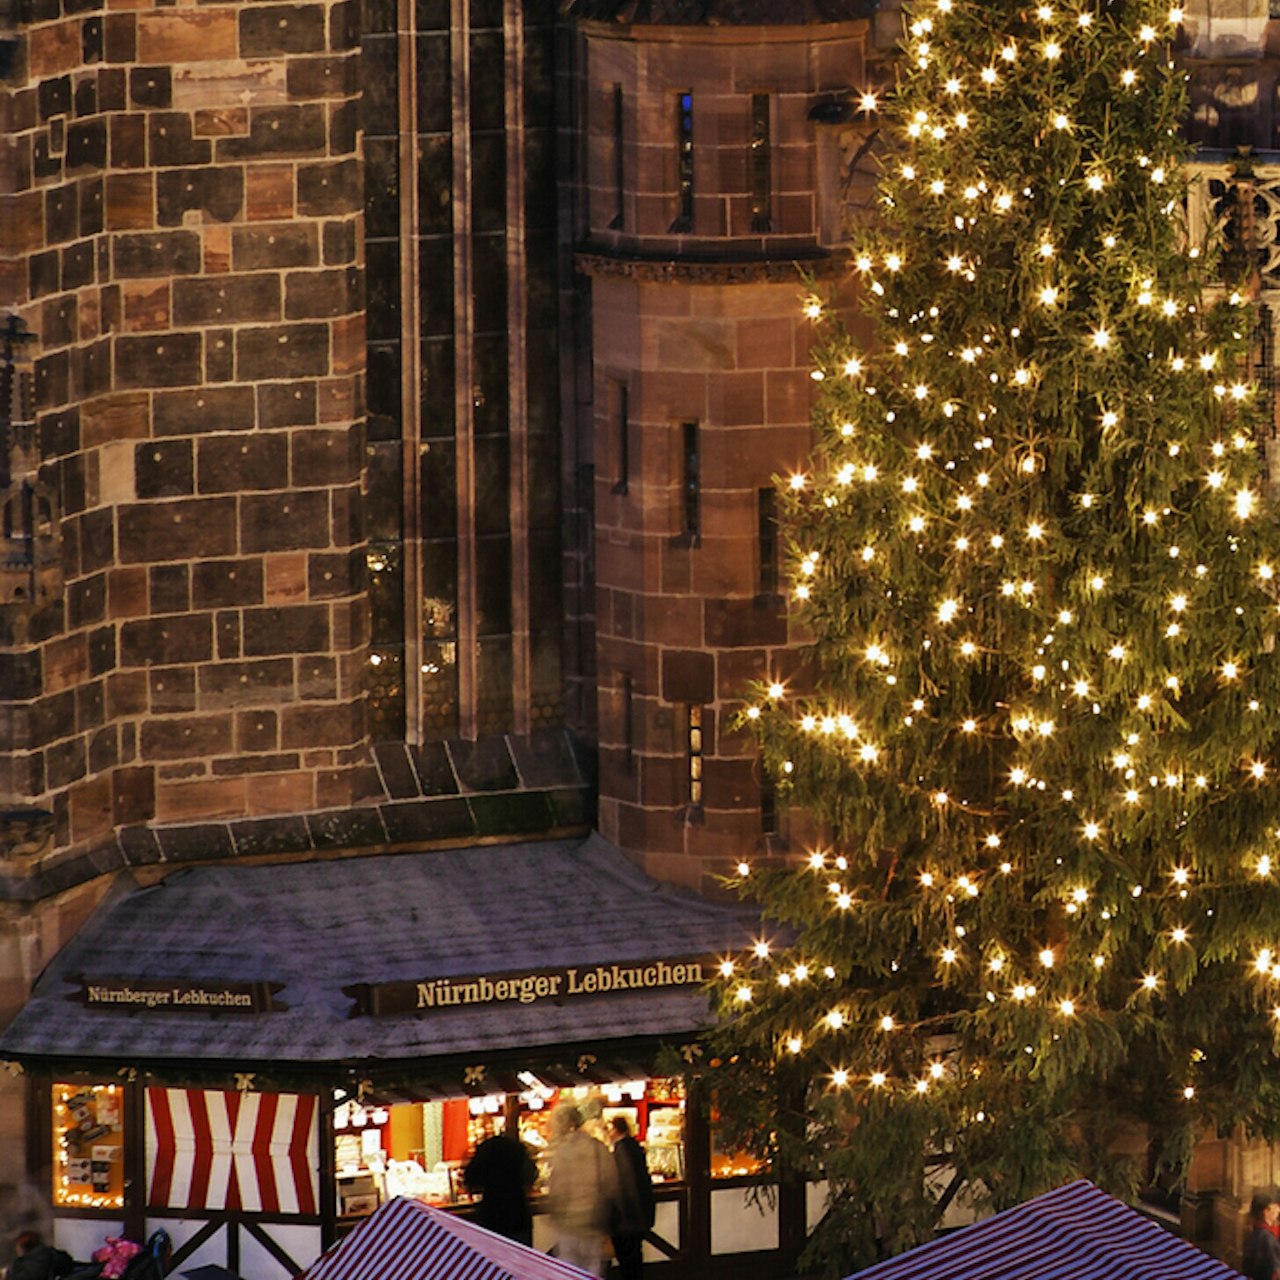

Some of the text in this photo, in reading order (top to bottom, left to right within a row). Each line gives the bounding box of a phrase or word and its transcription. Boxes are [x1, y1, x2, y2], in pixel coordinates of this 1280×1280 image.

[87, 985, 252, 1008] Nürnberger Lebkuchen
[416, 962, 702, 1008] Nürnberger Lebkuchen
